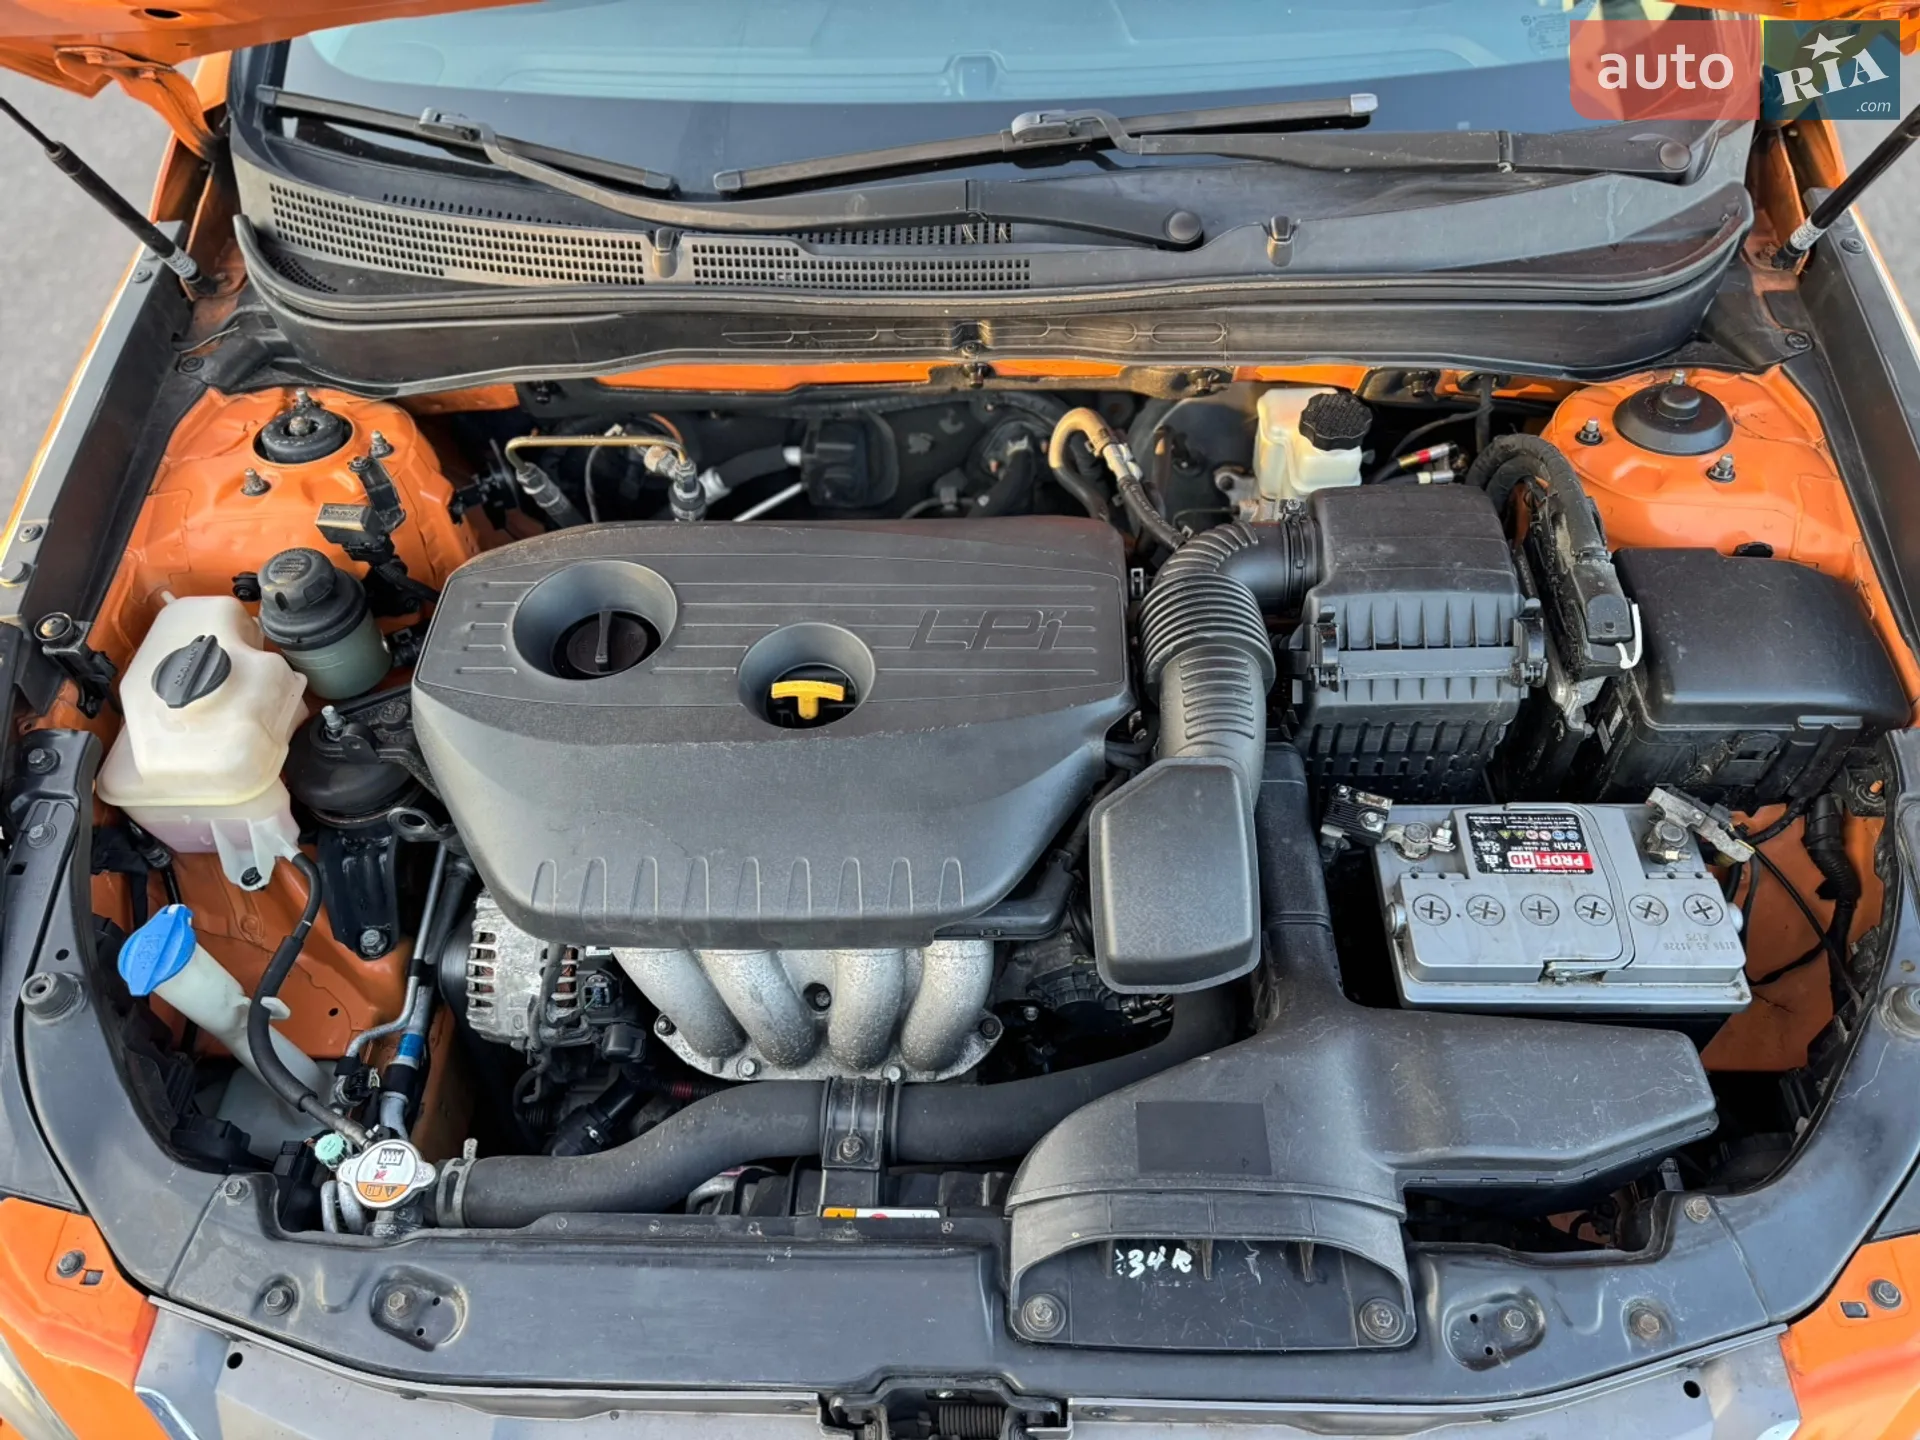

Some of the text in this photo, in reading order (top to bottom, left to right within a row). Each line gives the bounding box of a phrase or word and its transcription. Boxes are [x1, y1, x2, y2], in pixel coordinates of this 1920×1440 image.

[909, 608, 1068, 651] LPi
[1553, 841, 1582, 851] 65Ah
[1510, 854, 1584, 867] PROFI HD
